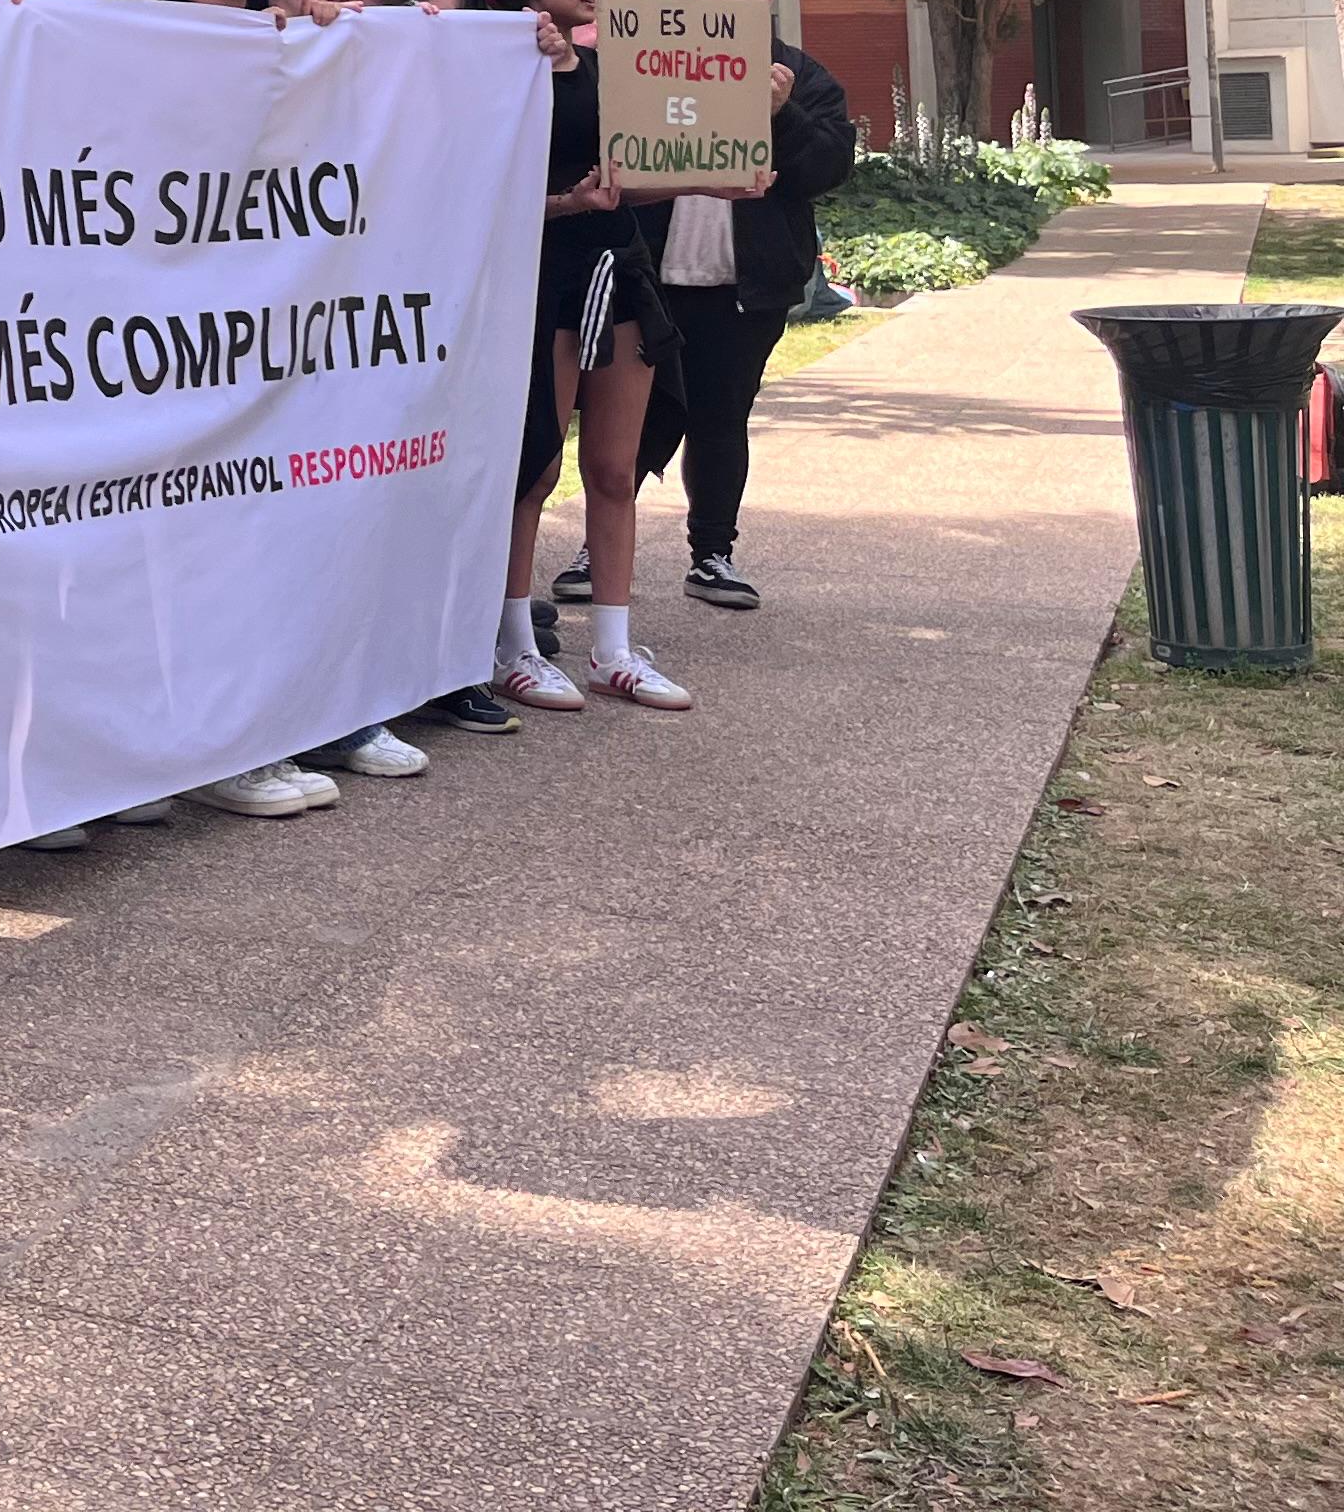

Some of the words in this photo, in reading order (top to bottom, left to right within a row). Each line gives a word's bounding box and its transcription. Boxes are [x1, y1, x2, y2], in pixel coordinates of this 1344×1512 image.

[609, 8, 639, 38] NO
[661, 9, 686, 36] ES
[703, 13, 735, 39] UN
[666, 97, 697, 126] ES
[21, 146, 135, 247] MÉS
[155, 161, 365, 246] SILENCI.
[87, 292, 446, 398] COMPLICITAT.
[76, 483, 87, 521] I
[89, 472, 159, 517] ESTAT
[162, 455, 283, 507] ESPANYOL
[288, 430, 447, 488] RESPONSABLES
